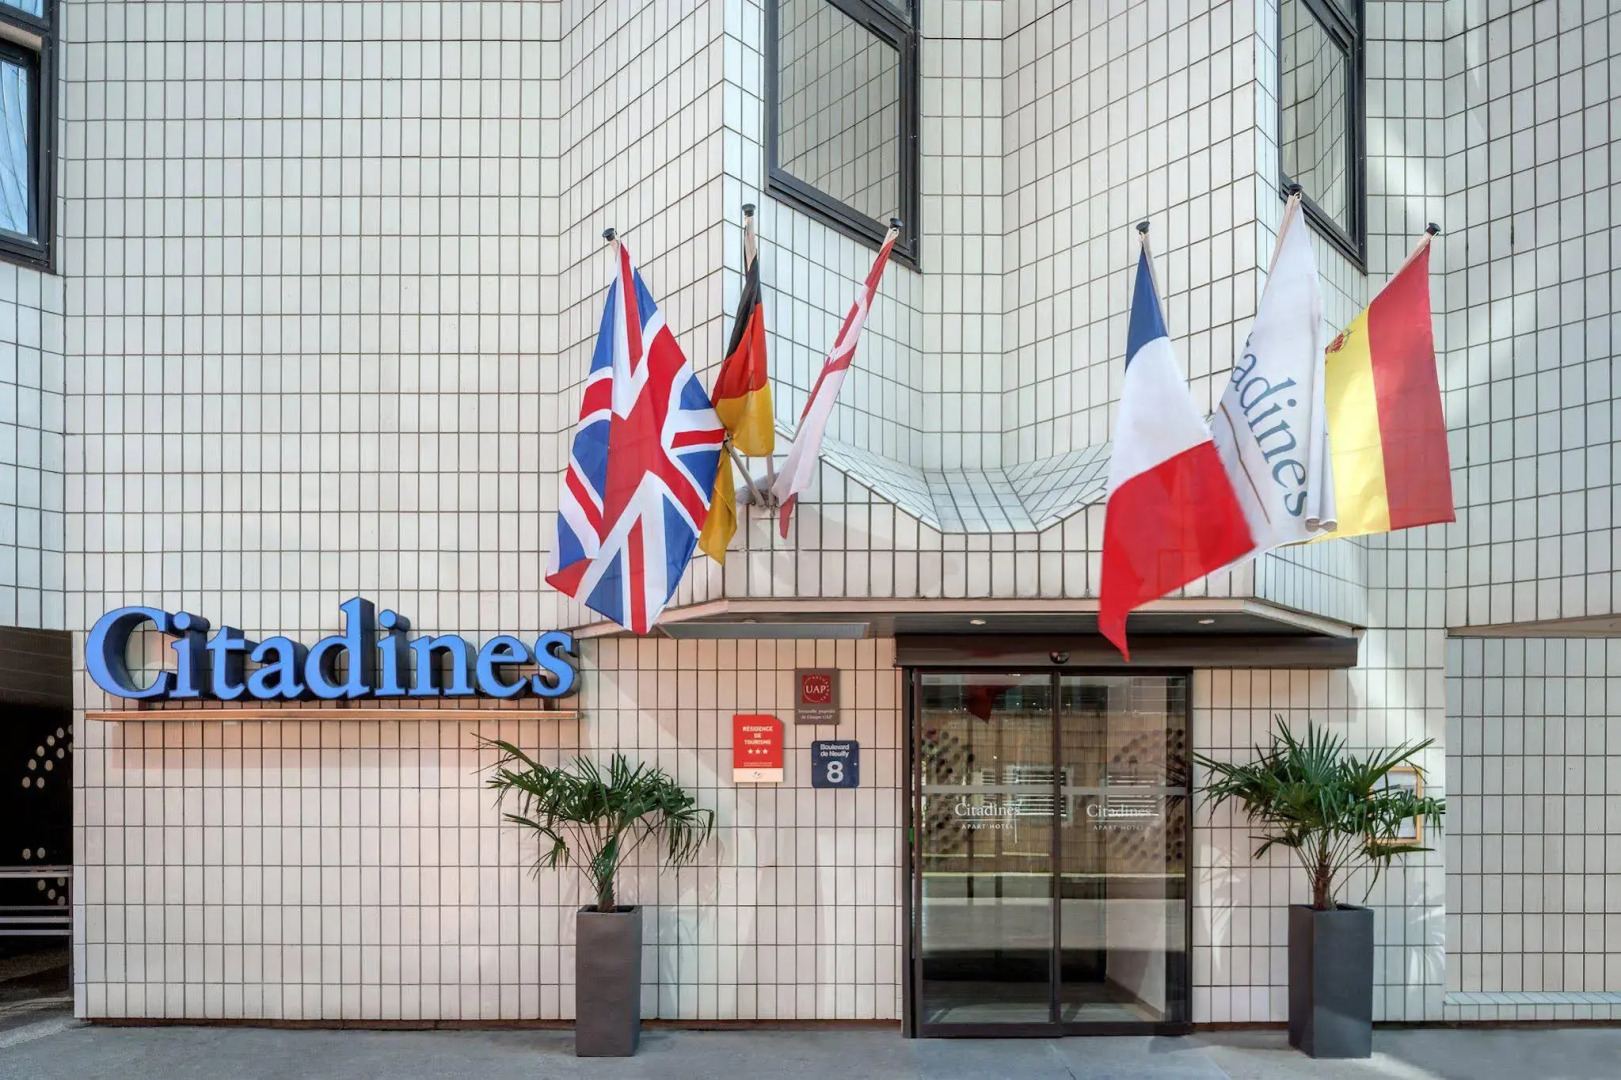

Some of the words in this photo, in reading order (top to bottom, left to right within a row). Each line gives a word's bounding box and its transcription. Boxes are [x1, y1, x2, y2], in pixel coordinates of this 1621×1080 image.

[1231, 332, 1308, 517] adines
[85, 597, 580, 700] Citadines
[805, 685, 827, 694] UAP
[826, 761, 844, 783] 8
[955, 802, 1021, 816] Citadines
